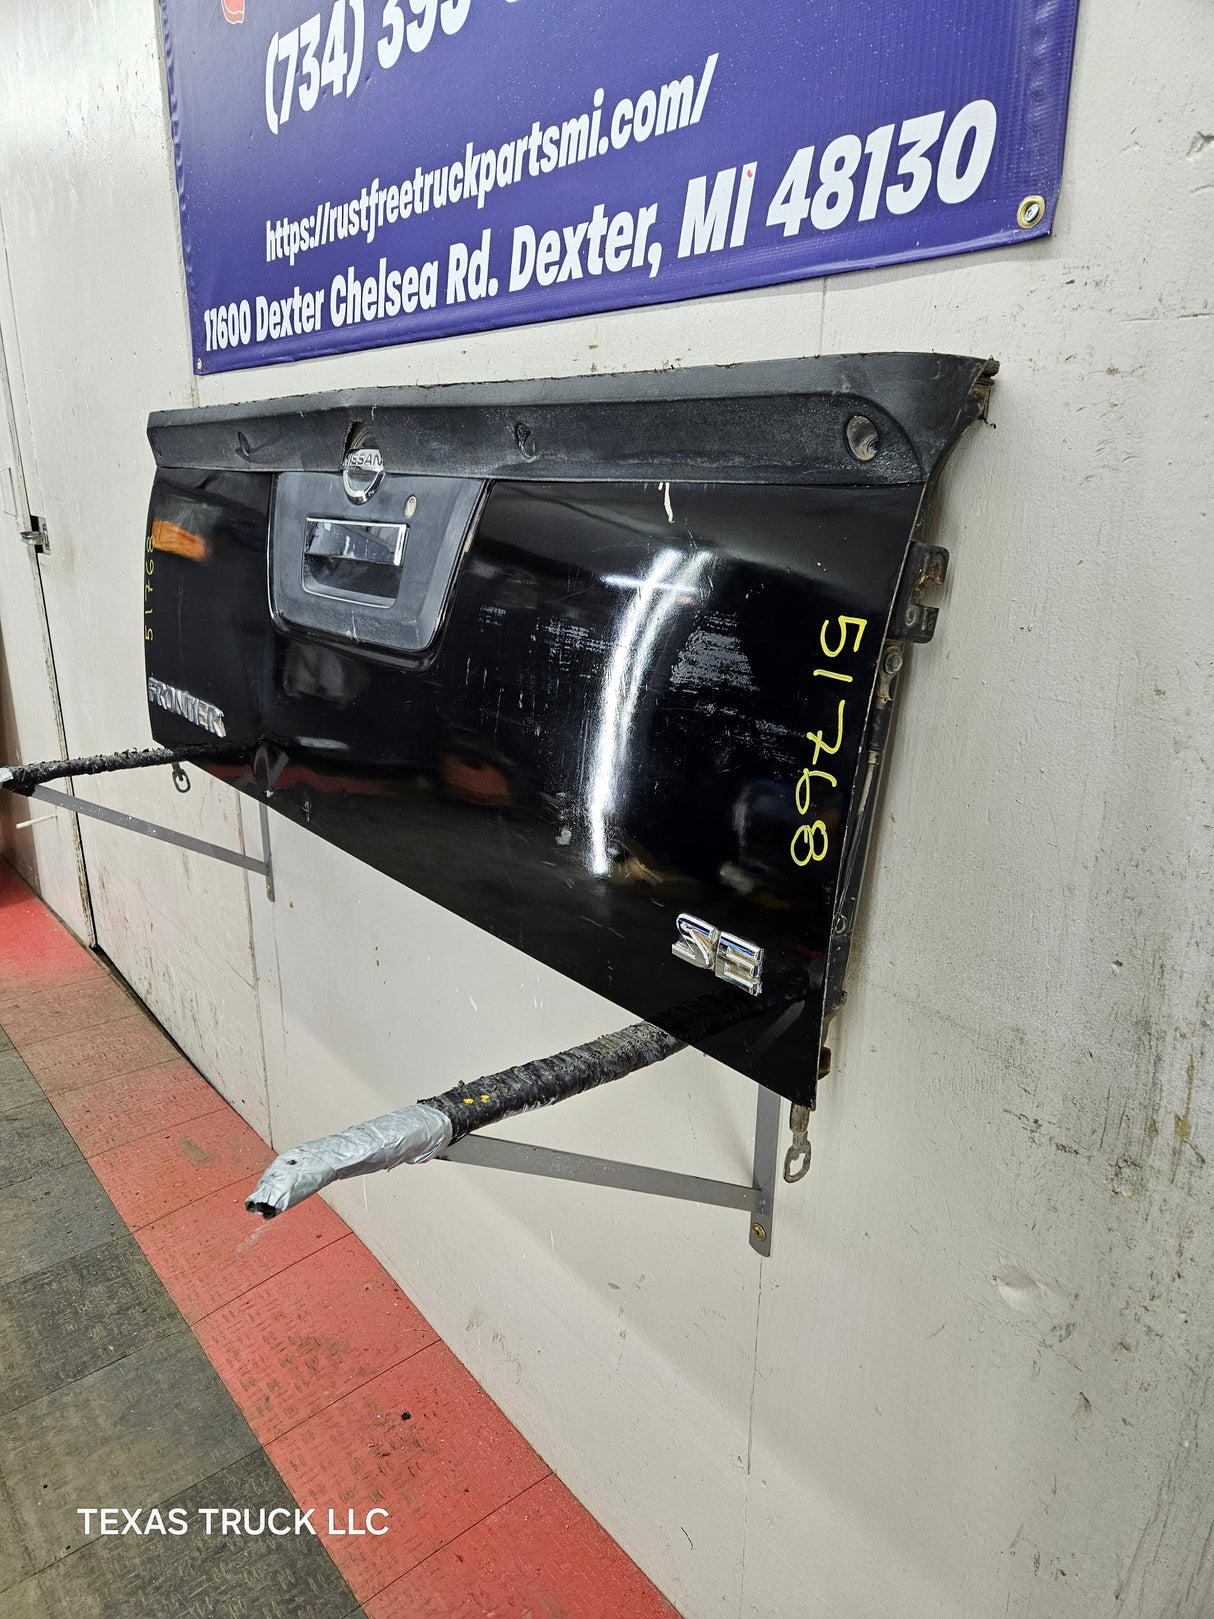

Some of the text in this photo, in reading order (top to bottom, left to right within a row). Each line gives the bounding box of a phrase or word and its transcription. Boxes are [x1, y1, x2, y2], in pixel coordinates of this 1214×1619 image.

[265, 0, 365, 135] (734)
[203, 99, 998, 352] 11600 Dexter Chelsea Rd. Dexter, MI 48130
[265, 53, 720, 266] https://rustfreetruckpartsmi.com/
[148, 676, 227, 739] FRONTIER
[790, 615, 868, 867] 51768
[671, 912, 765, 997] SE
